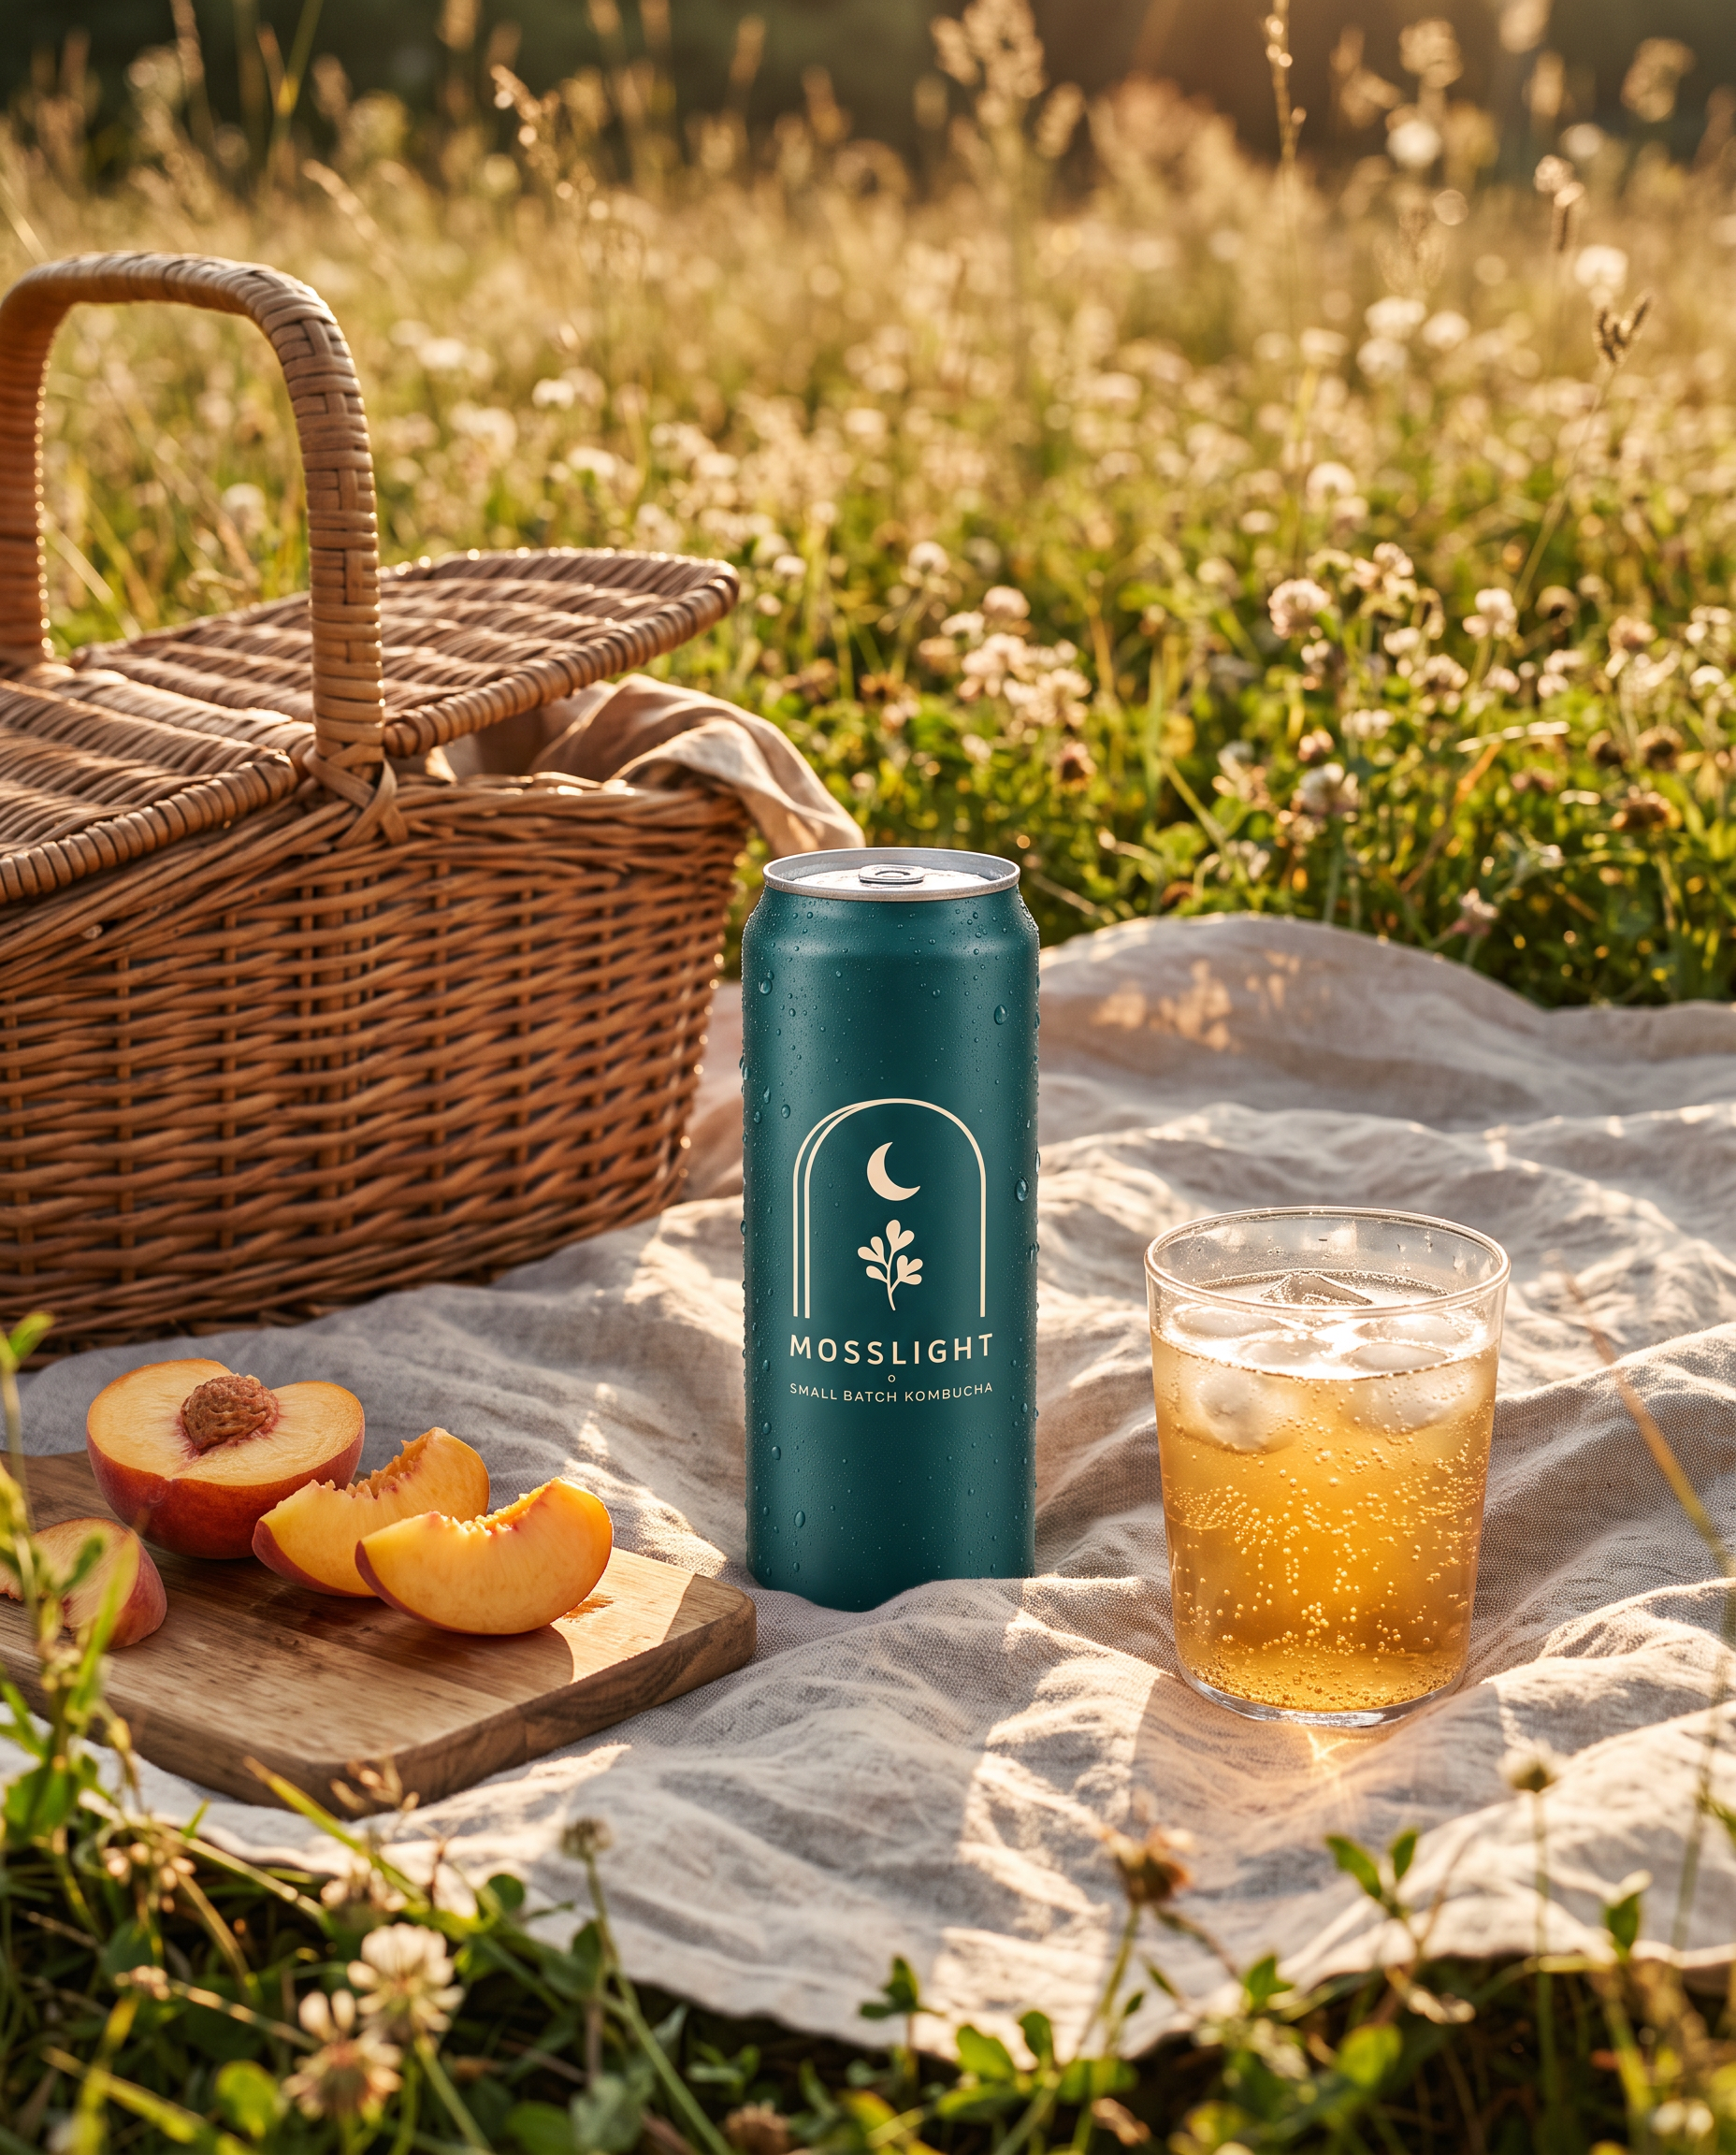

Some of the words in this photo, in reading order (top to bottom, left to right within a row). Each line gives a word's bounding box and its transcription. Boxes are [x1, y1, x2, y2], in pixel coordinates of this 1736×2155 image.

[789, 1332, 993, 1366] MOSSLIGHT
[789, 1382, 838, 1400] SMALL
[843, 1390, 897, 1403] BATCH
[904, 1381, 993, 1402] KOMBUCHA
